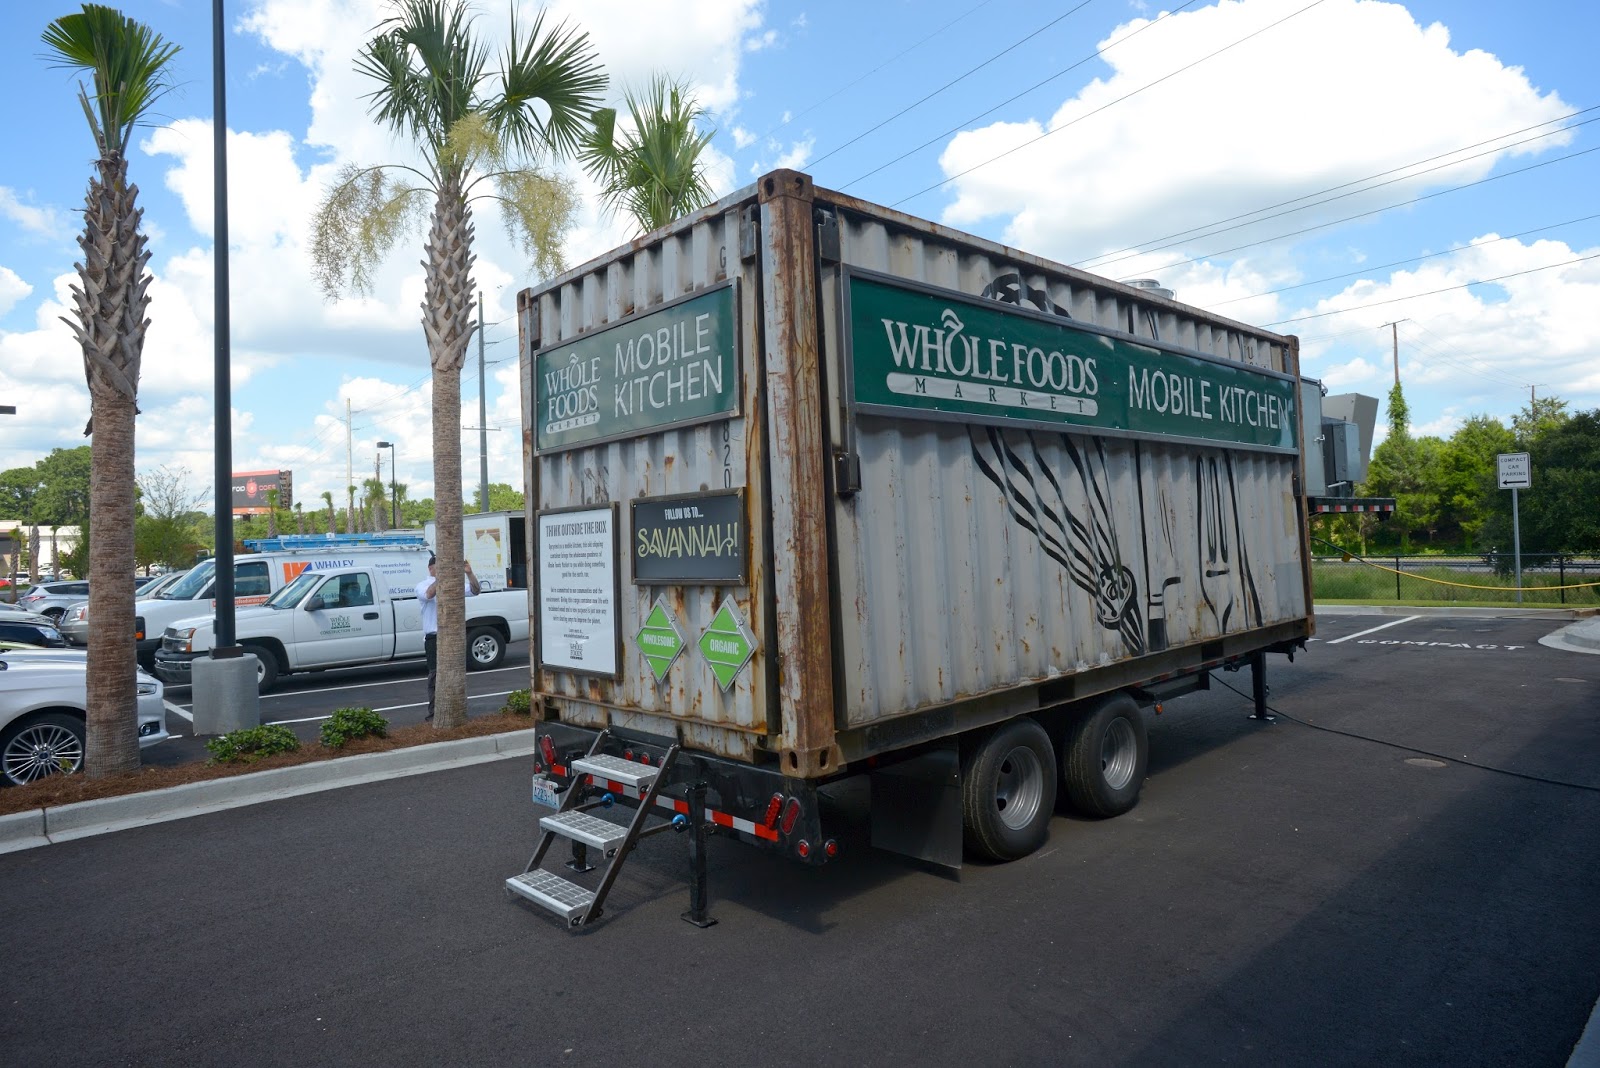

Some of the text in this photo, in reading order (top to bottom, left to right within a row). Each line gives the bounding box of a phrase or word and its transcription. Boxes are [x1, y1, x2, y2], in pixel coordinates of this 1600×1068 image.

[614, 312, 711, 379] MOBILE
[880, 308, 1099, 396] WHOLE FOODS
[545, 353, 601, 396] WHOLE
[614, 354, 723, 419] KITCHEN
[547, 384, 599, 421] FOODS
[914, 376, 1085, 413] MARKET
[1128, 365, 1290, 431] MOBILE KITCHEN
[549, 414, 597, 432] MARKET
[545, 520, 607, 537] THINK OUTSIDE THE BOX
[664, 508, 683, 520] FOLLOW
[683, 507, 691, 519] US
[637, 521, 738, 558] SAVANNAH!
[642, 633, 675, 648] WHOLESOME
[709, 638, 739, 656] ORGANIC
[1357, 639, 1525, 650] COMPACT
